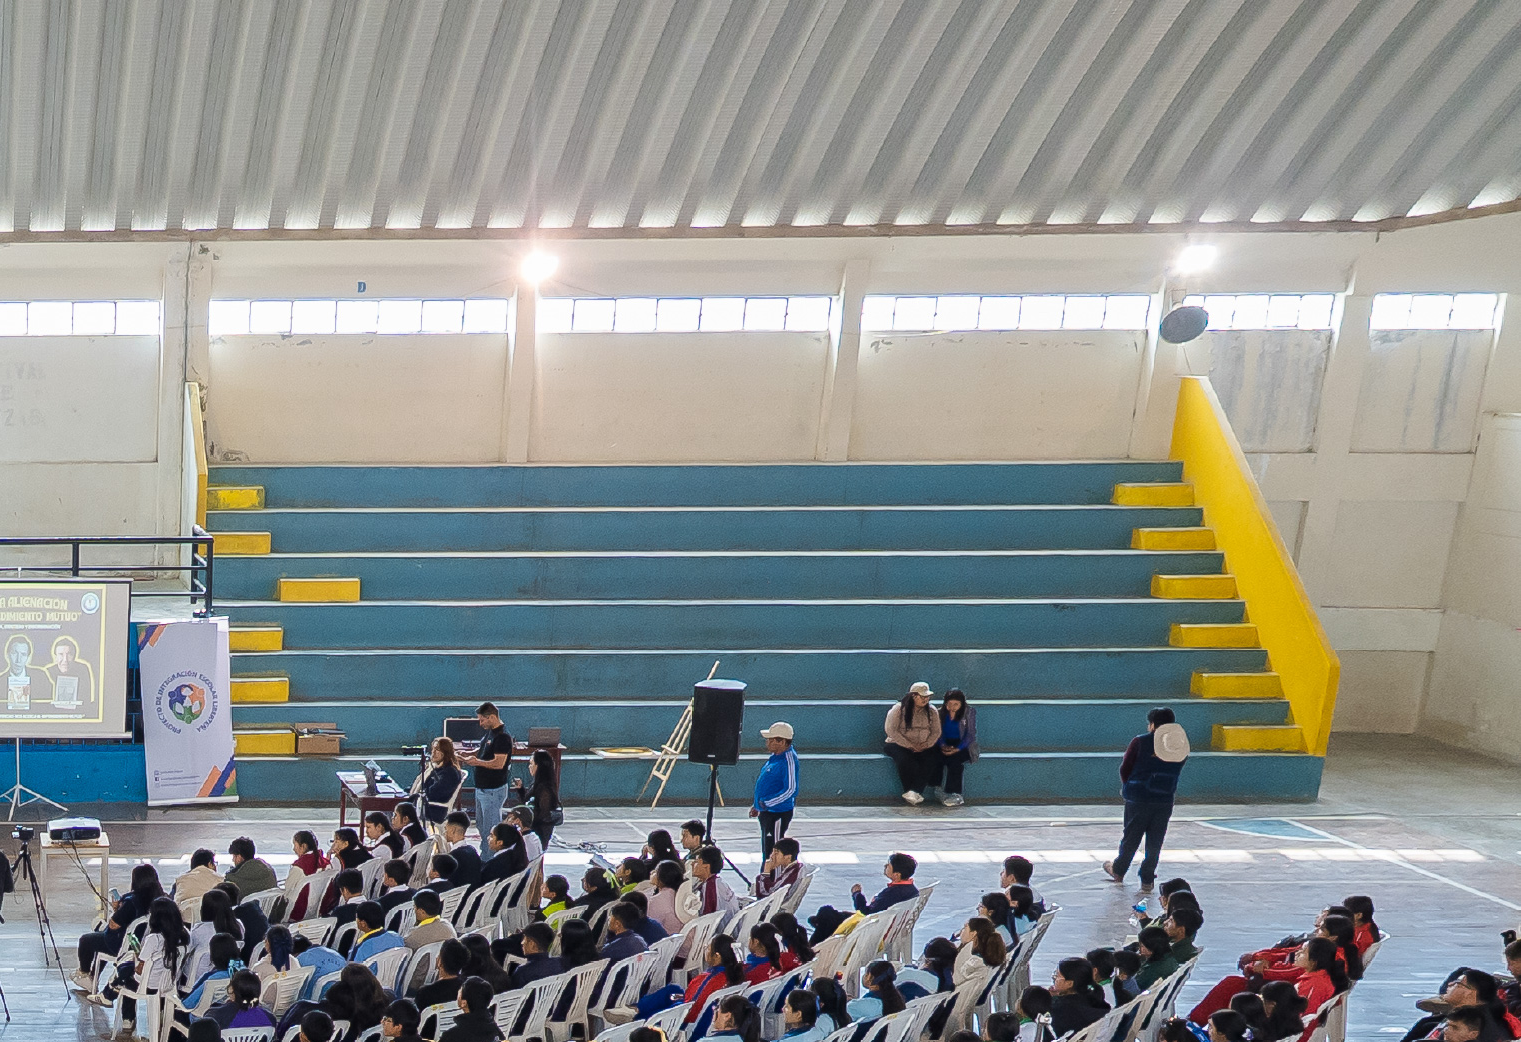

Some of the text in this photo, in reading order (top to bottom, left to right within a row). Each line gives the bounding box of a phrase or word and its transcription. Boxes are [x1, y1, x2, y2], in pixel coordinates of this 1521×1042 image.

[157, 670, 198, 696] INTEGRACIÓN
[198, 673, 218, 700] ESCOLAR
[155, 696, 162, 706] DE
[156, 706, 182, 734] PROYECTO
